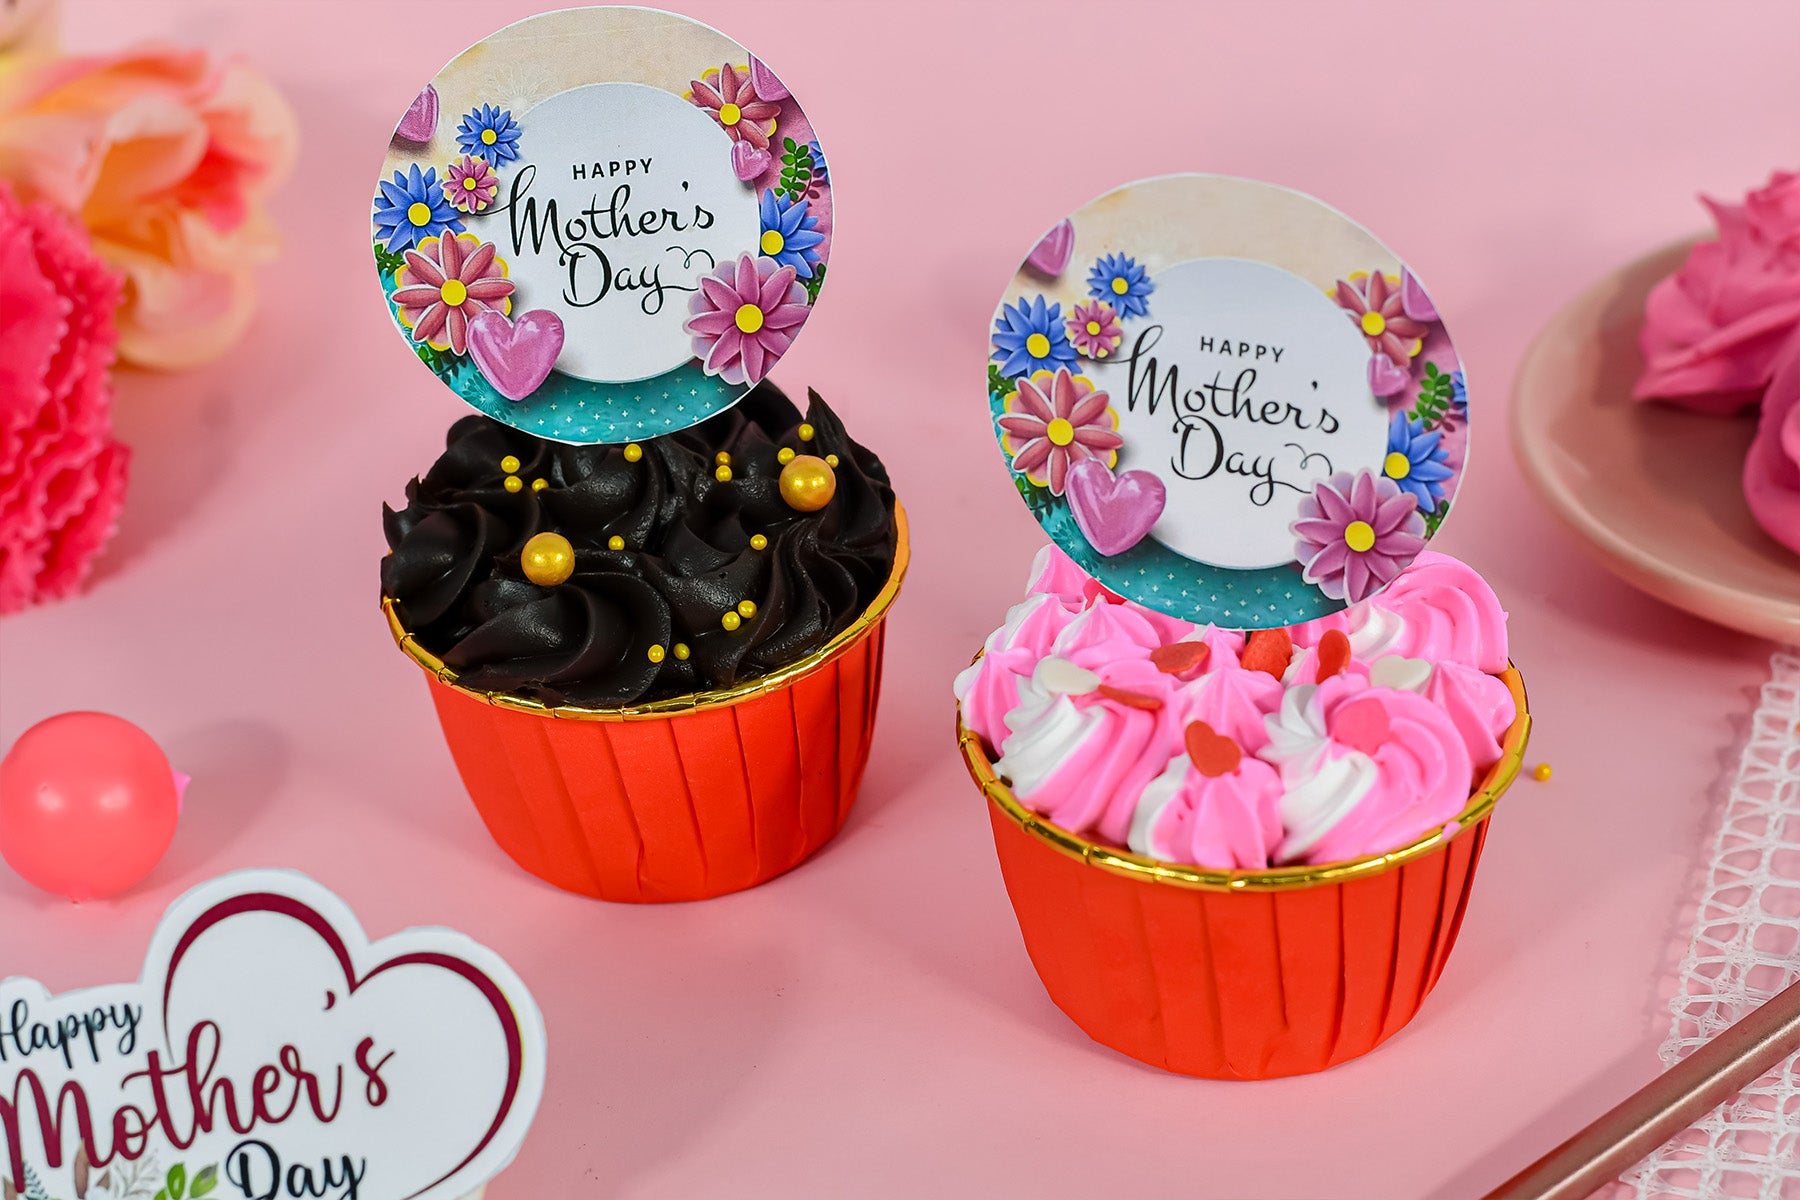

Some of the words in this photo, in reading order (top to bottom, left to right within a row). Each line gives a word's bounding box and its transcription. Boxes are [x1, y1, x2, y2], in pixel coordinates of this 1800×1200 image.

[572, 157, 653, 180] HAPPY
[484, 164, 715, 257] Mother's
[558, 242, 699, 316] Day
[1104, 324, 1340, 434] Mother's
[1200, 336, 1285, 363] HAPPY
[1170, 414, 1312, 507] Day
[0, 999, 143, 1070] Happy
[0, 990, 396, 1194] Mother's
[225, 1139, 367, 1200] Day
